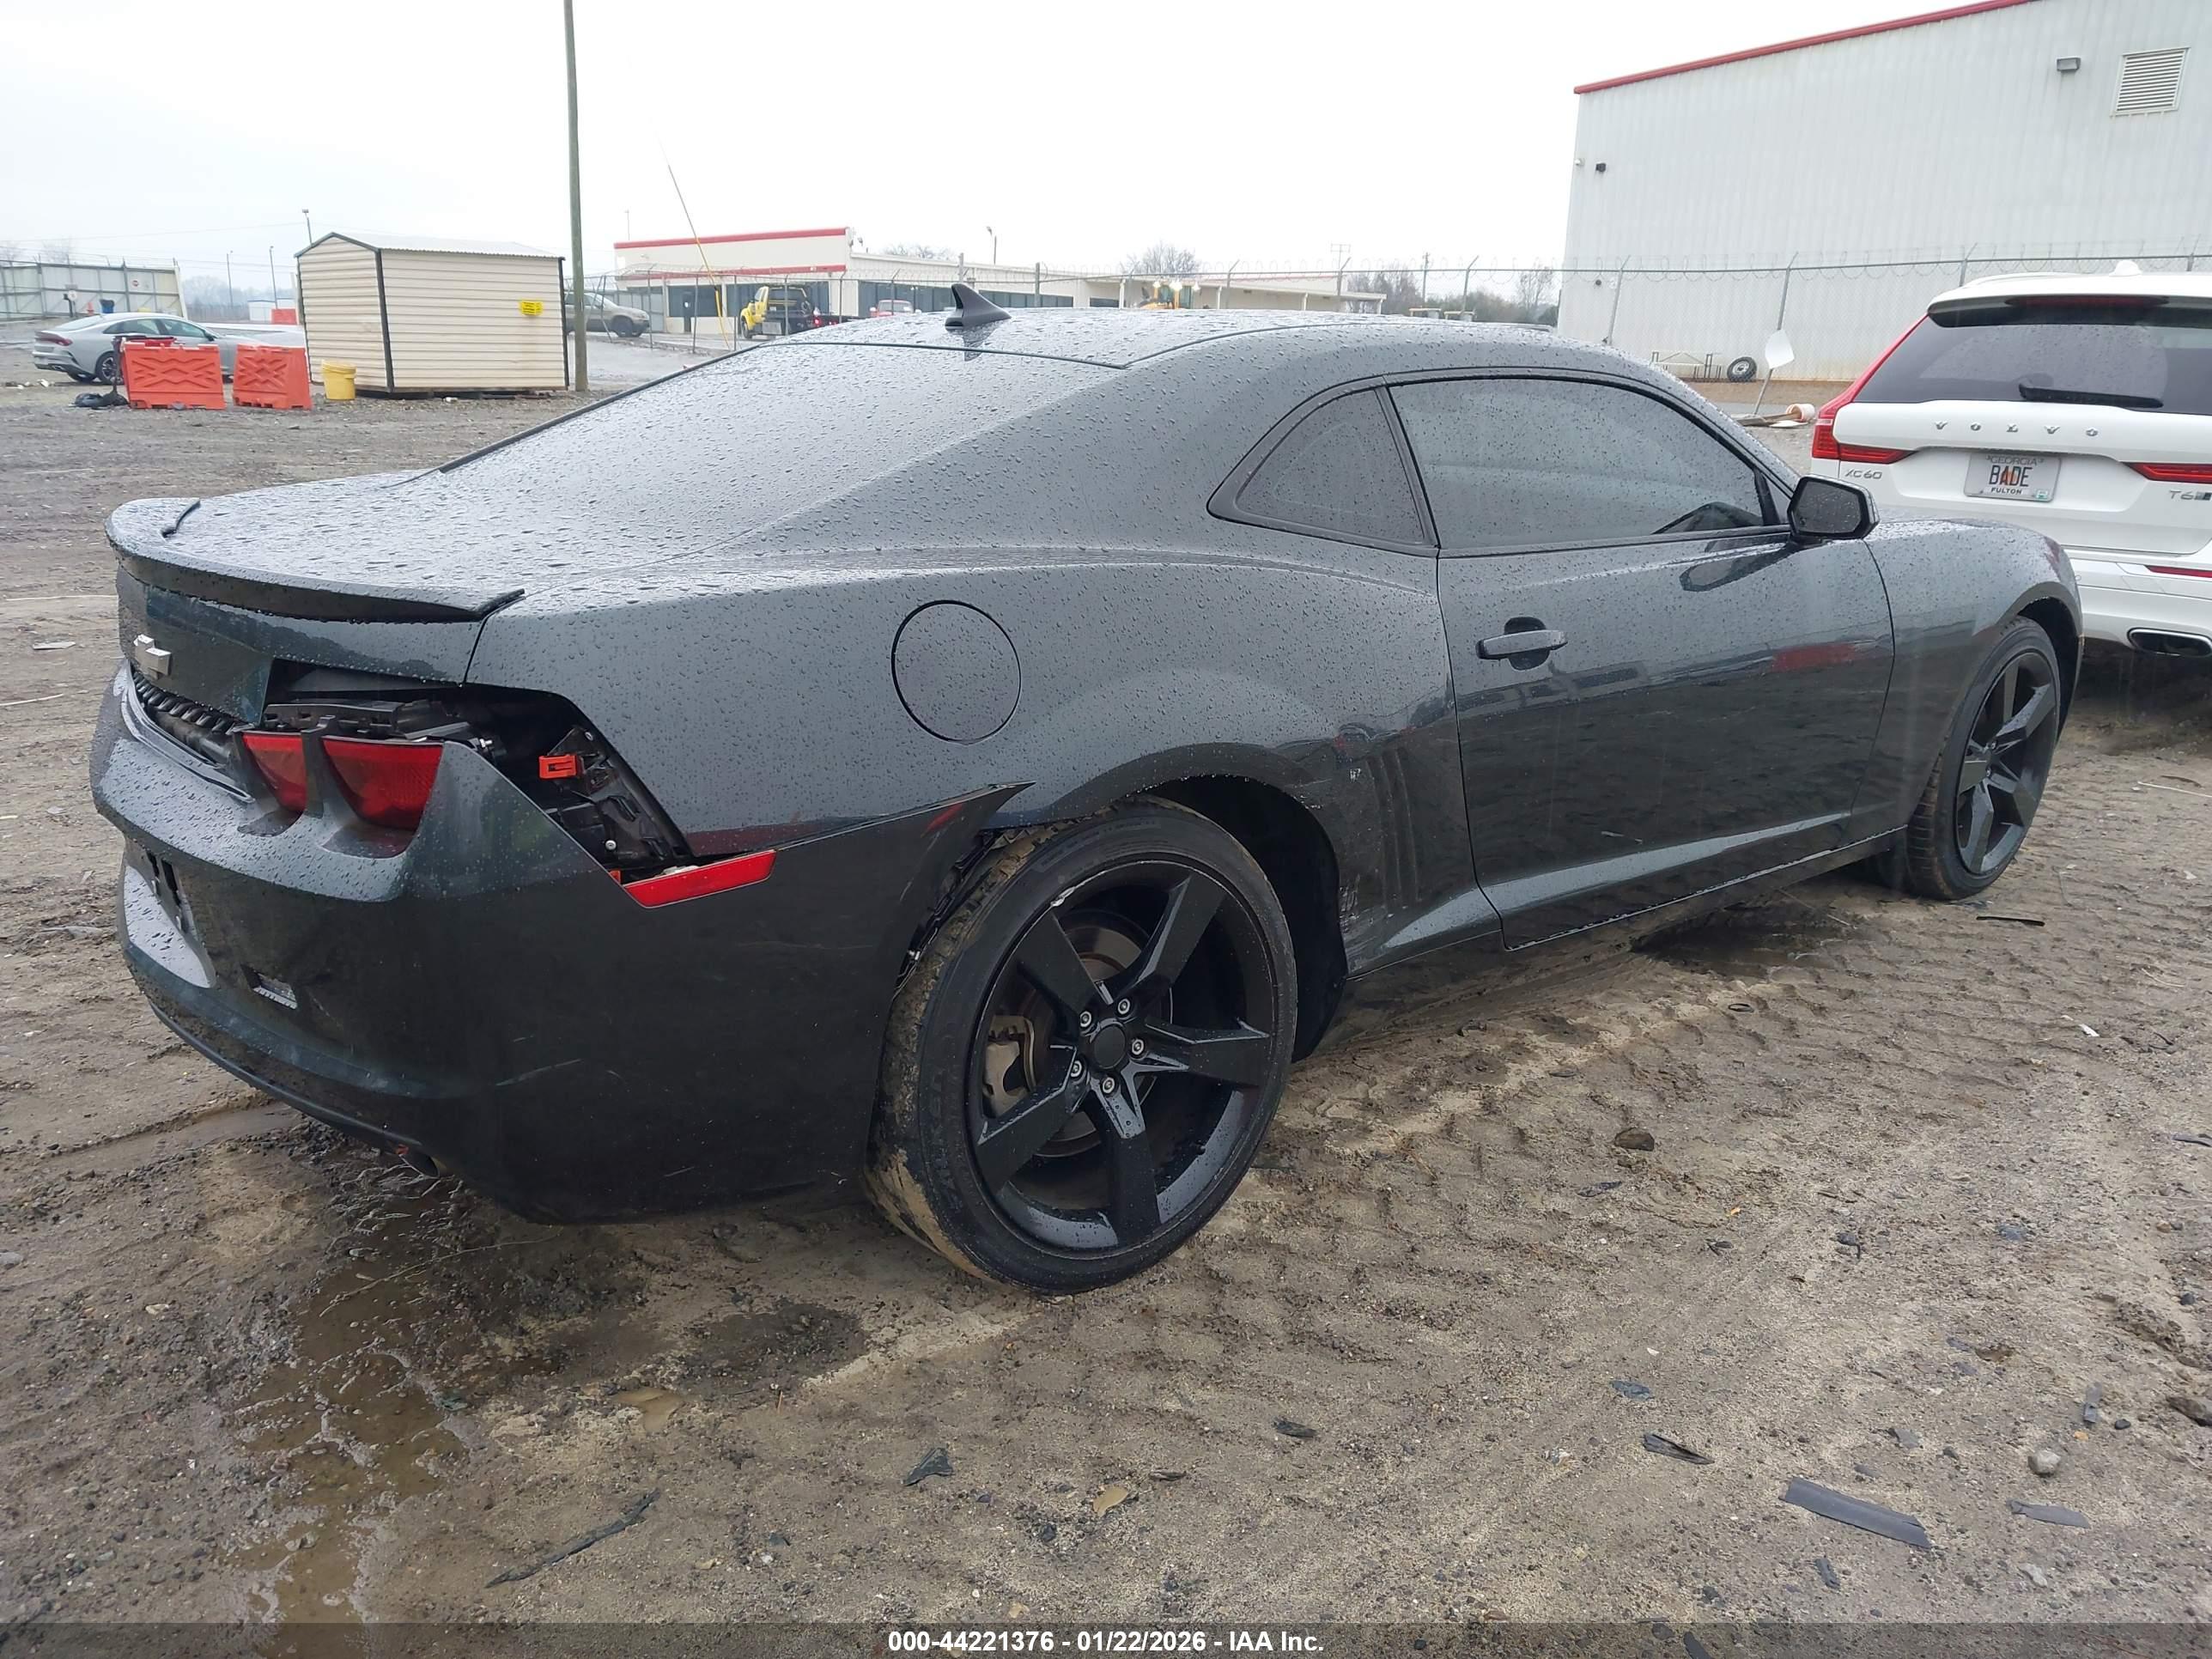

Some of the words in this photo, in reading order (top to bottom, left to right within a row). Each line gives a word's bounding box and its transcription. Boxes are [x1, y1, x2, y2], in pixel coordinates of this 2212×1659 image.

[1935, 421, 2099, 437] VOLVO
[1990, 455, 2038, 465] GEORGIA
[1844, 468, 1883, 479] XC60
[1989, 465, 2033, 487] BADE
[2170, 490, 2194, 500] T6
